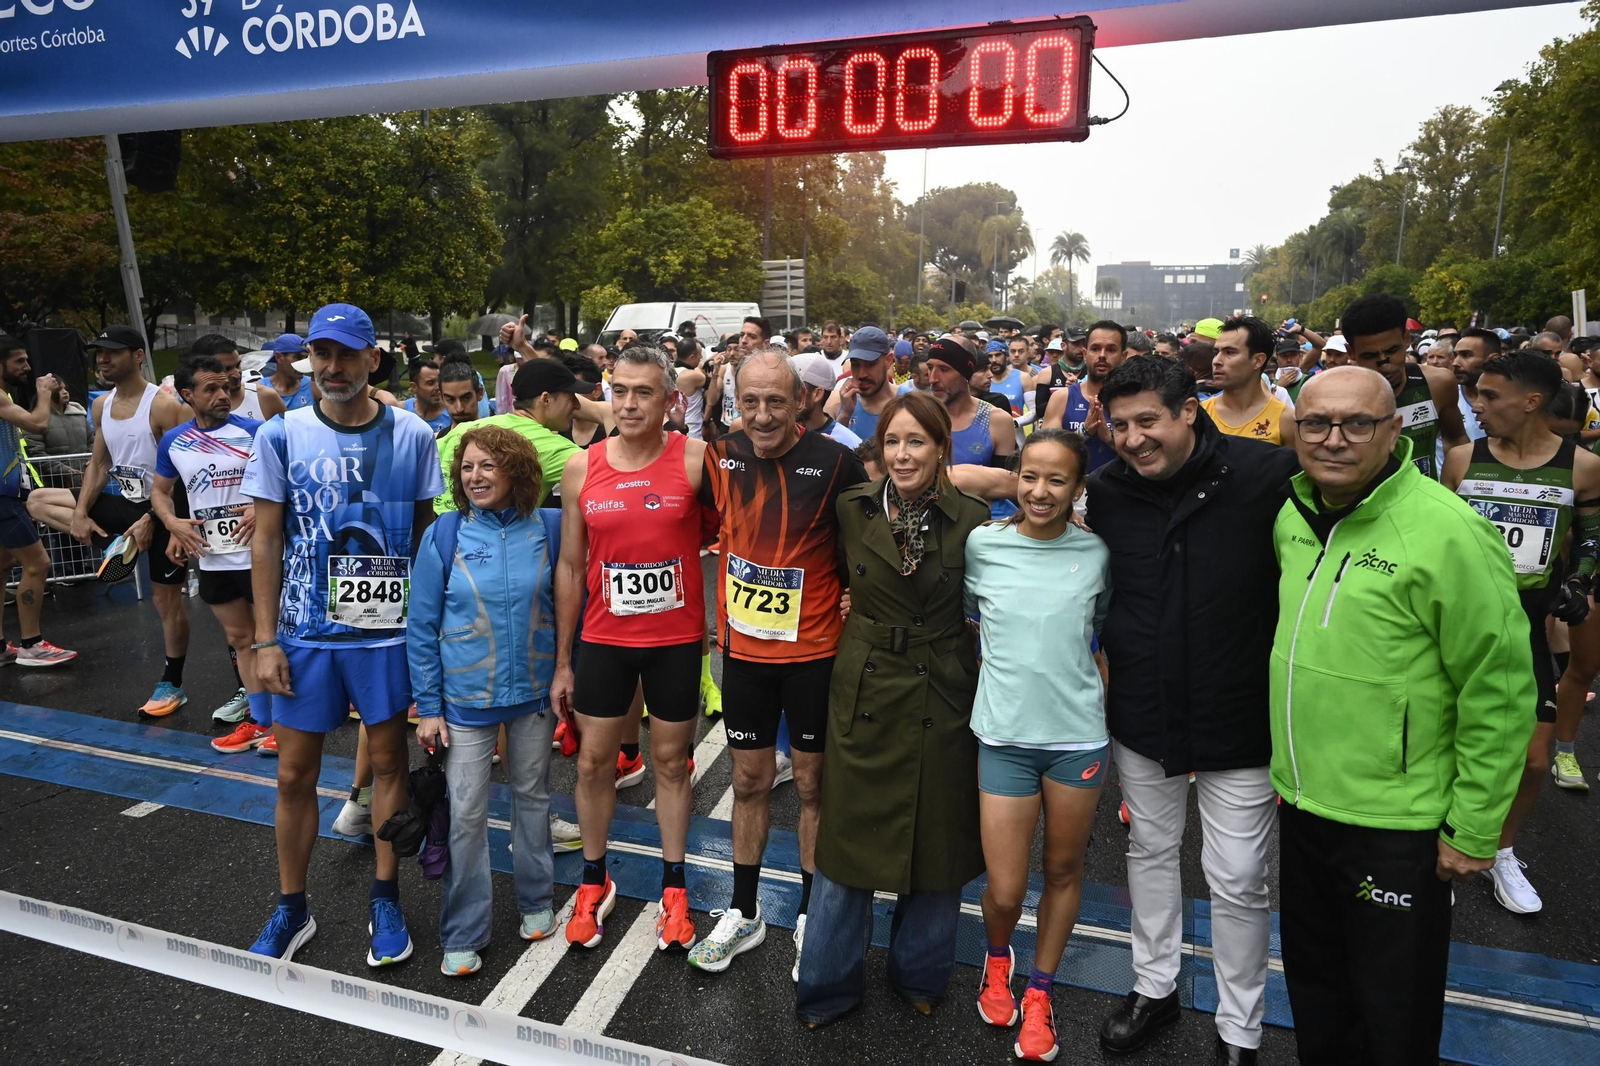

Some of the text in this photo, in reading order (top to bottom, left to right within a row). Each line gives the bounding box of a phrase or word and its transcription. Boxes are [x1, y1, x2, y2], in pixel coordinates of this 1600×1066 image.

[242, 0, 426, 55] CÓRDOBA
[0, 26, 105, 53] ortes Córdoba
[795, 467, 823, 477] 42K
[592, 500, 625, 511] califas
[1509, 506, 1538, 515] MEDIA
[1298, 537, 1316, 547] PARRA
[371, 558, 396, 566] MEDIA
[757, 568, 785, 577] MEDIA
[612, 570, 674, 595] 1300
[339, 580, 402, 603] 2848
[732, 580, 790, 614] 7723
[1371, 888, 1412, 907] CAC
